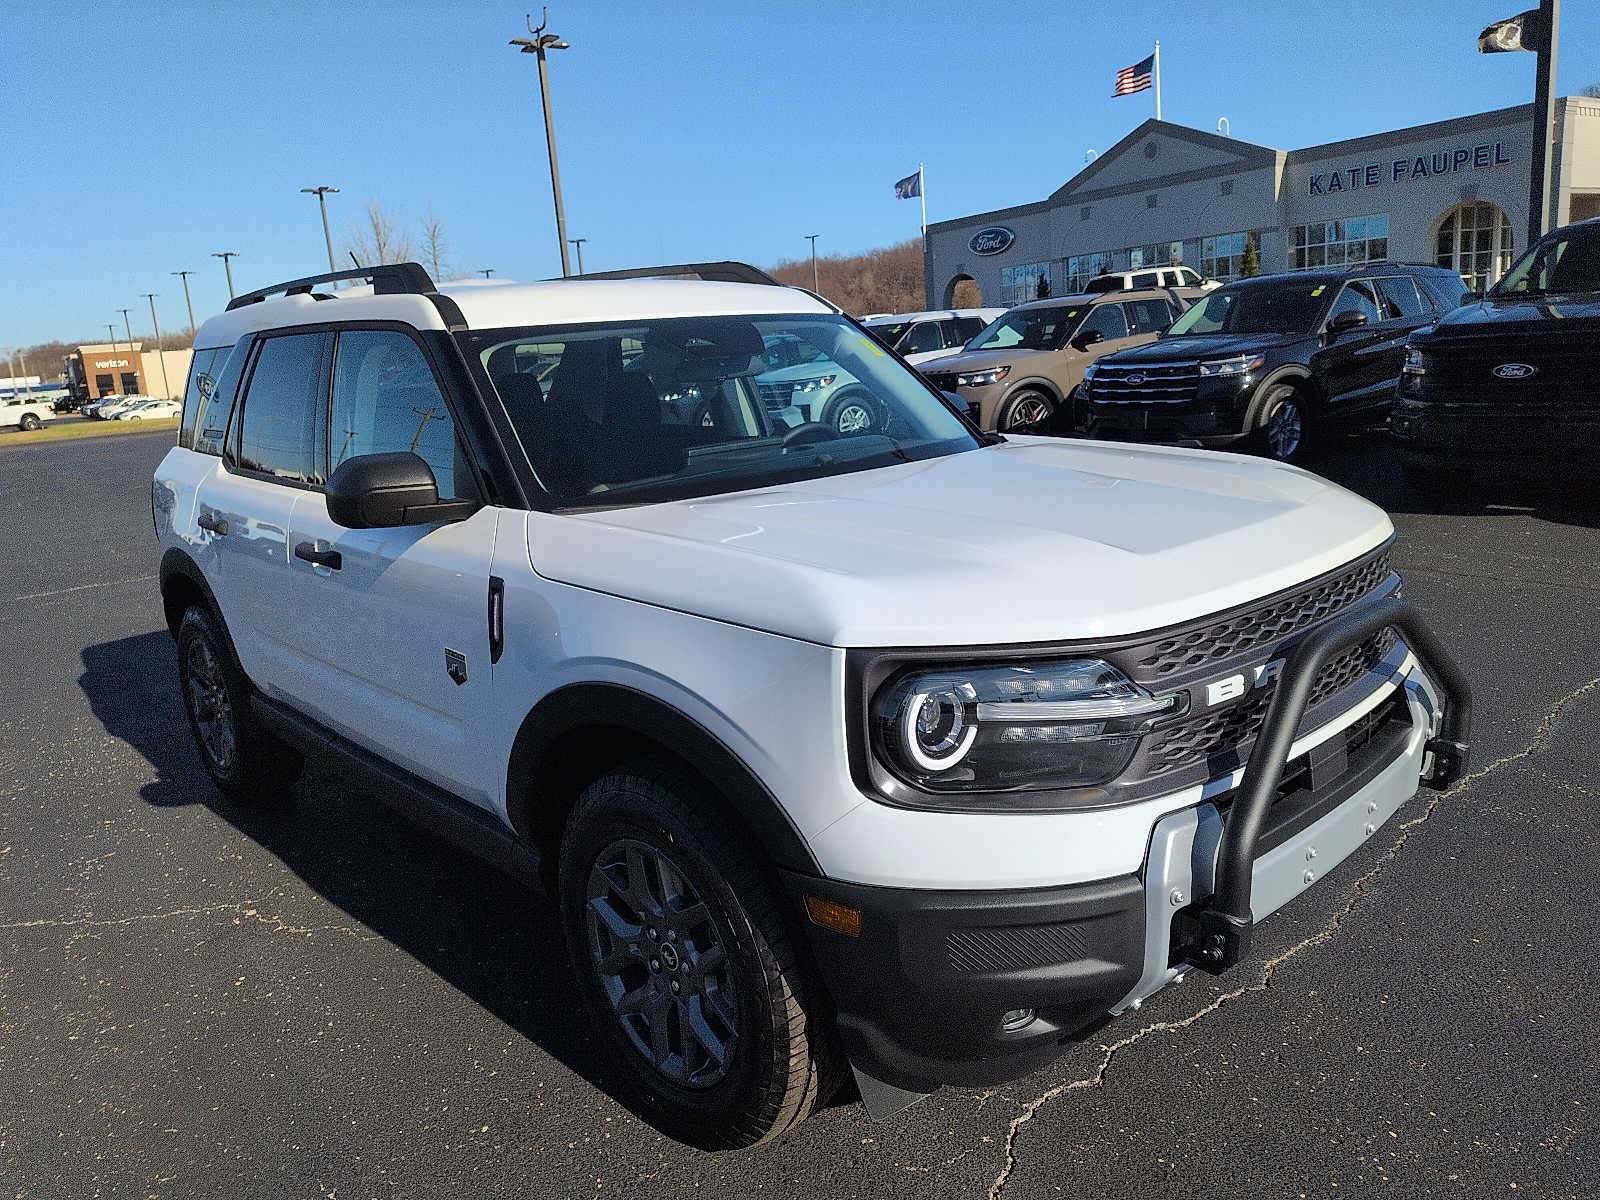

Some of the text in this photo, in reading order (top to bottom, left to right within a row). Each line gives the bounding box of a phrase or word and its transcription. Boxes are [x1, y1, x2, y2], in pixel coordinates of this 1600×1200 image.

[1309, 141, 1512, 196] KATE FAUPEL
[95, 359, 129, 369] verizon
